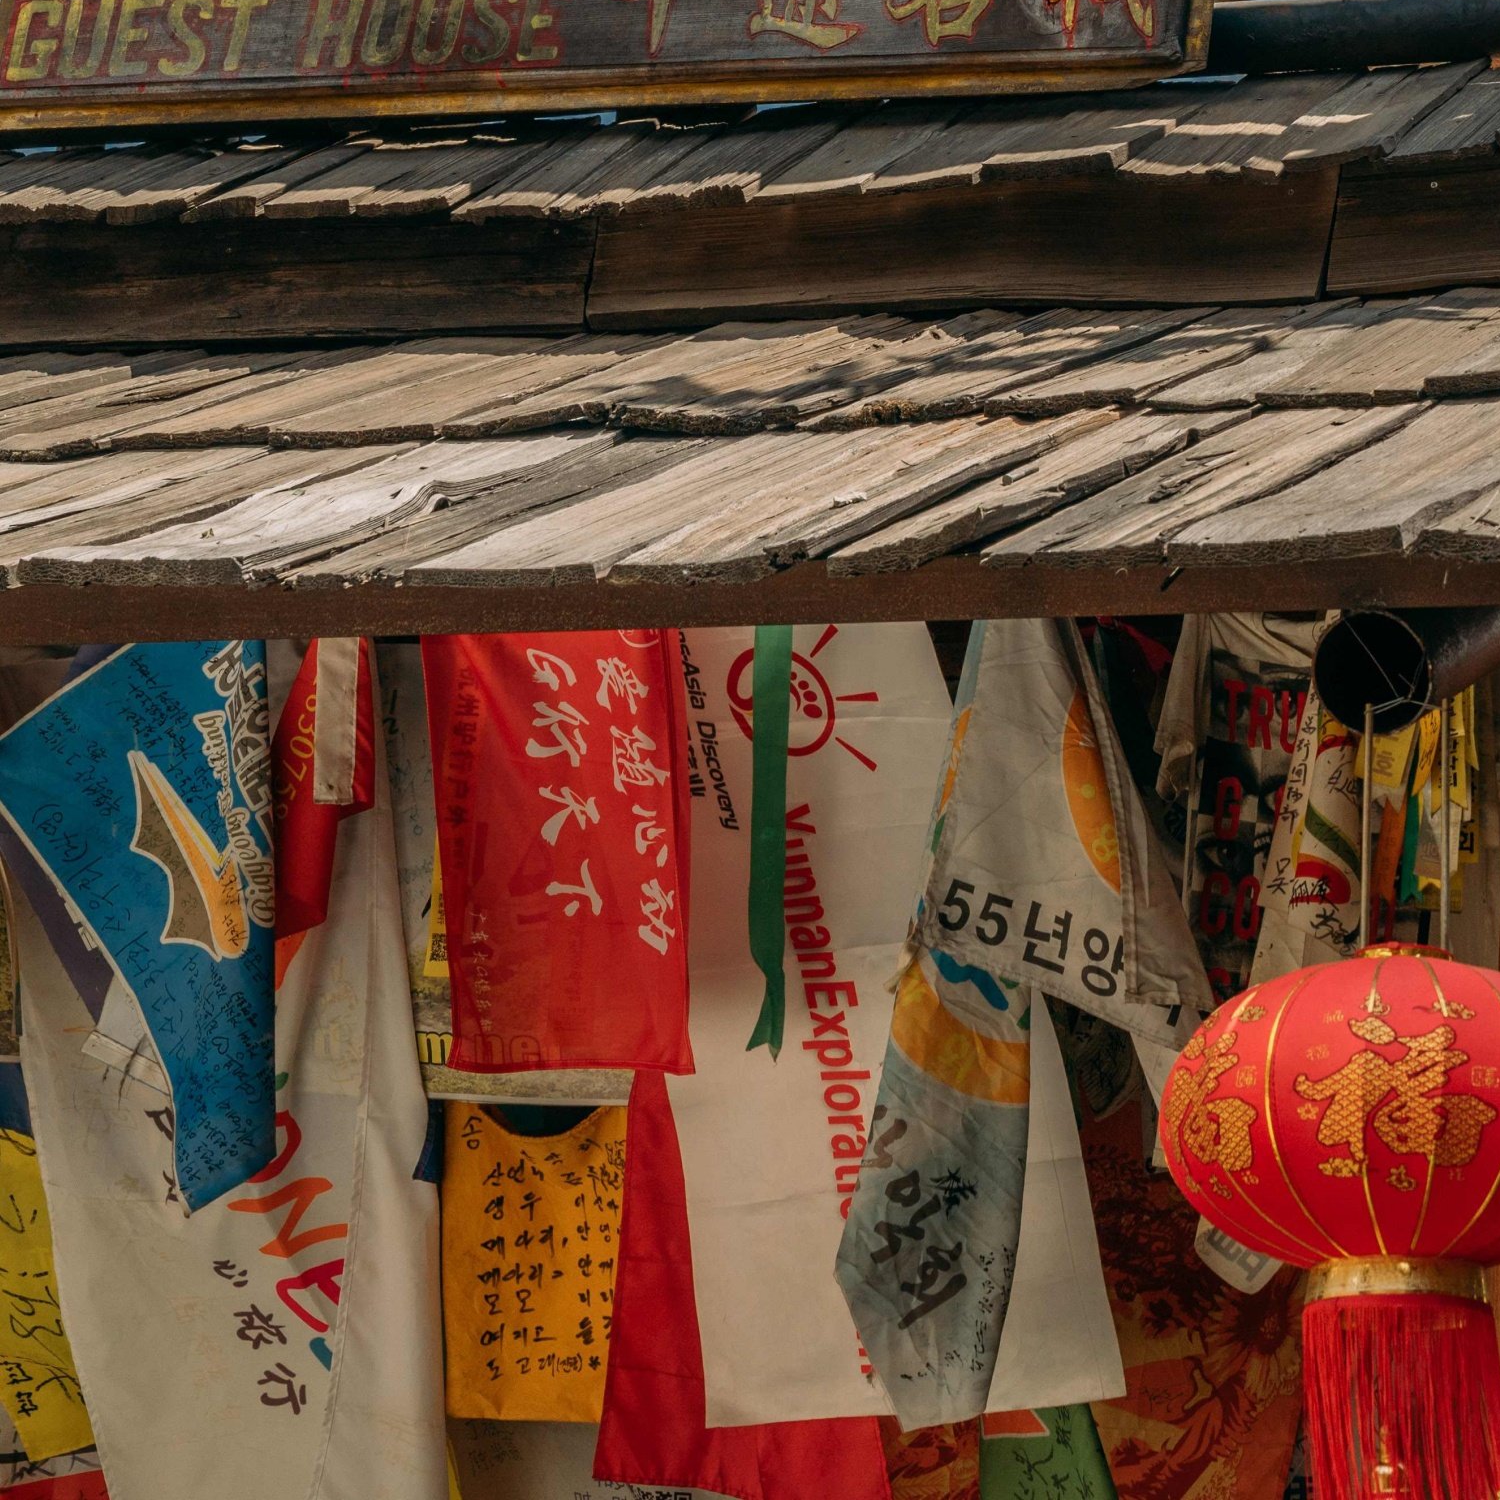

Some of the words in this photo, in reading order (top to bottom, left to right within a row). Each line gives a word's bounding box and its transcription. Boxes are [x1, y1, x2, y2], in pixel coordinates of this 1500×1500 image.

[594, 655, 677, 957] 爱随心动
[696, 719, 741, 831] Discovery
[1292, 1016, 1498, 1167] 福
